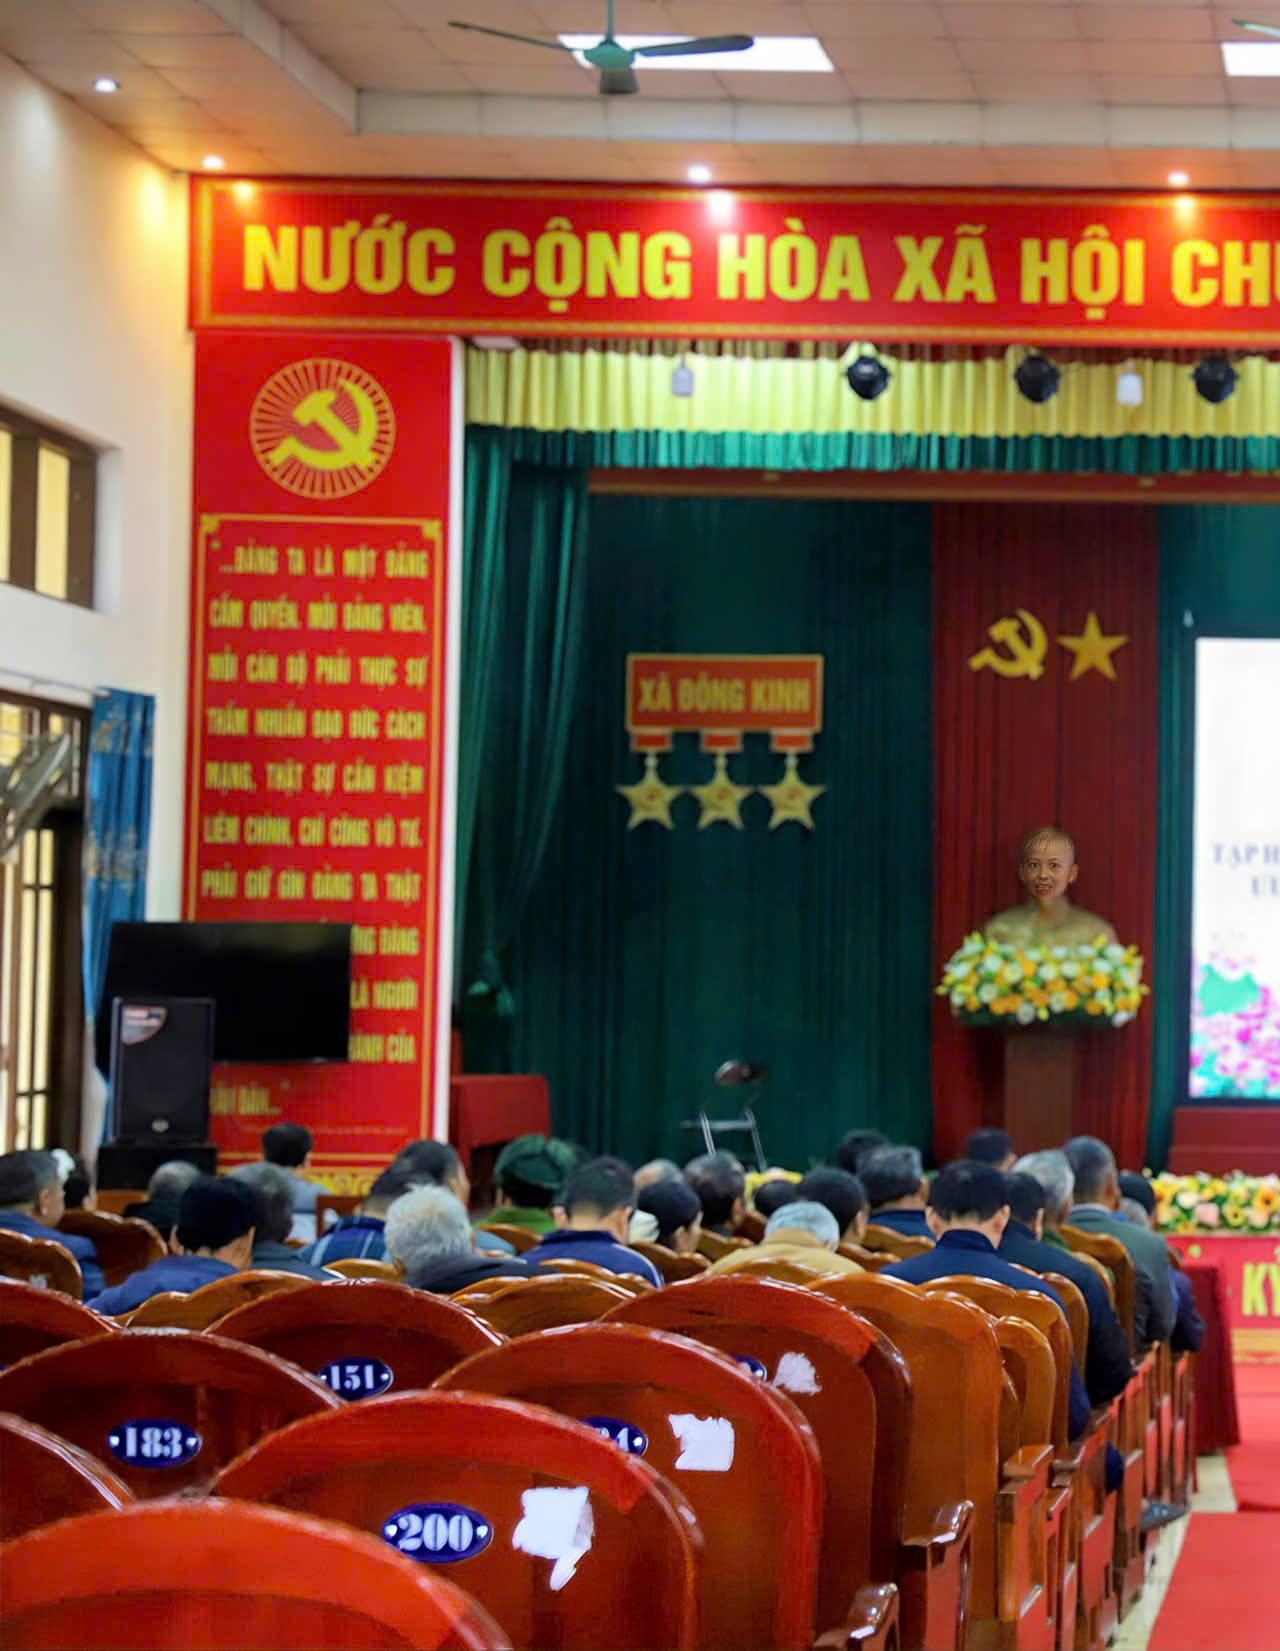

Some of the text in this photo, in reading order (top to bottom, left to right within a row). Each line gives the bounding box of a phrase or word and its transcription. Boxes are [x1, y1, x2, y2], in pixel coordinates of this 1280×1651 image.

[244, 214, 456, 296] NƯỚC
[482, 217, 691, 312] CỘNG
[717, 217, 871, 301] HÒA
[893, 224, 997, 304] XÃ
[1020, 224, 1145, 319] HỘI
[639, 672, 810, 712] XÃ ĐỒNG KINH
[329, 1364, 374, 1391] 151
[126, 1427, 182, 1457] 183
[399, 1514, 473, 1551] 200
